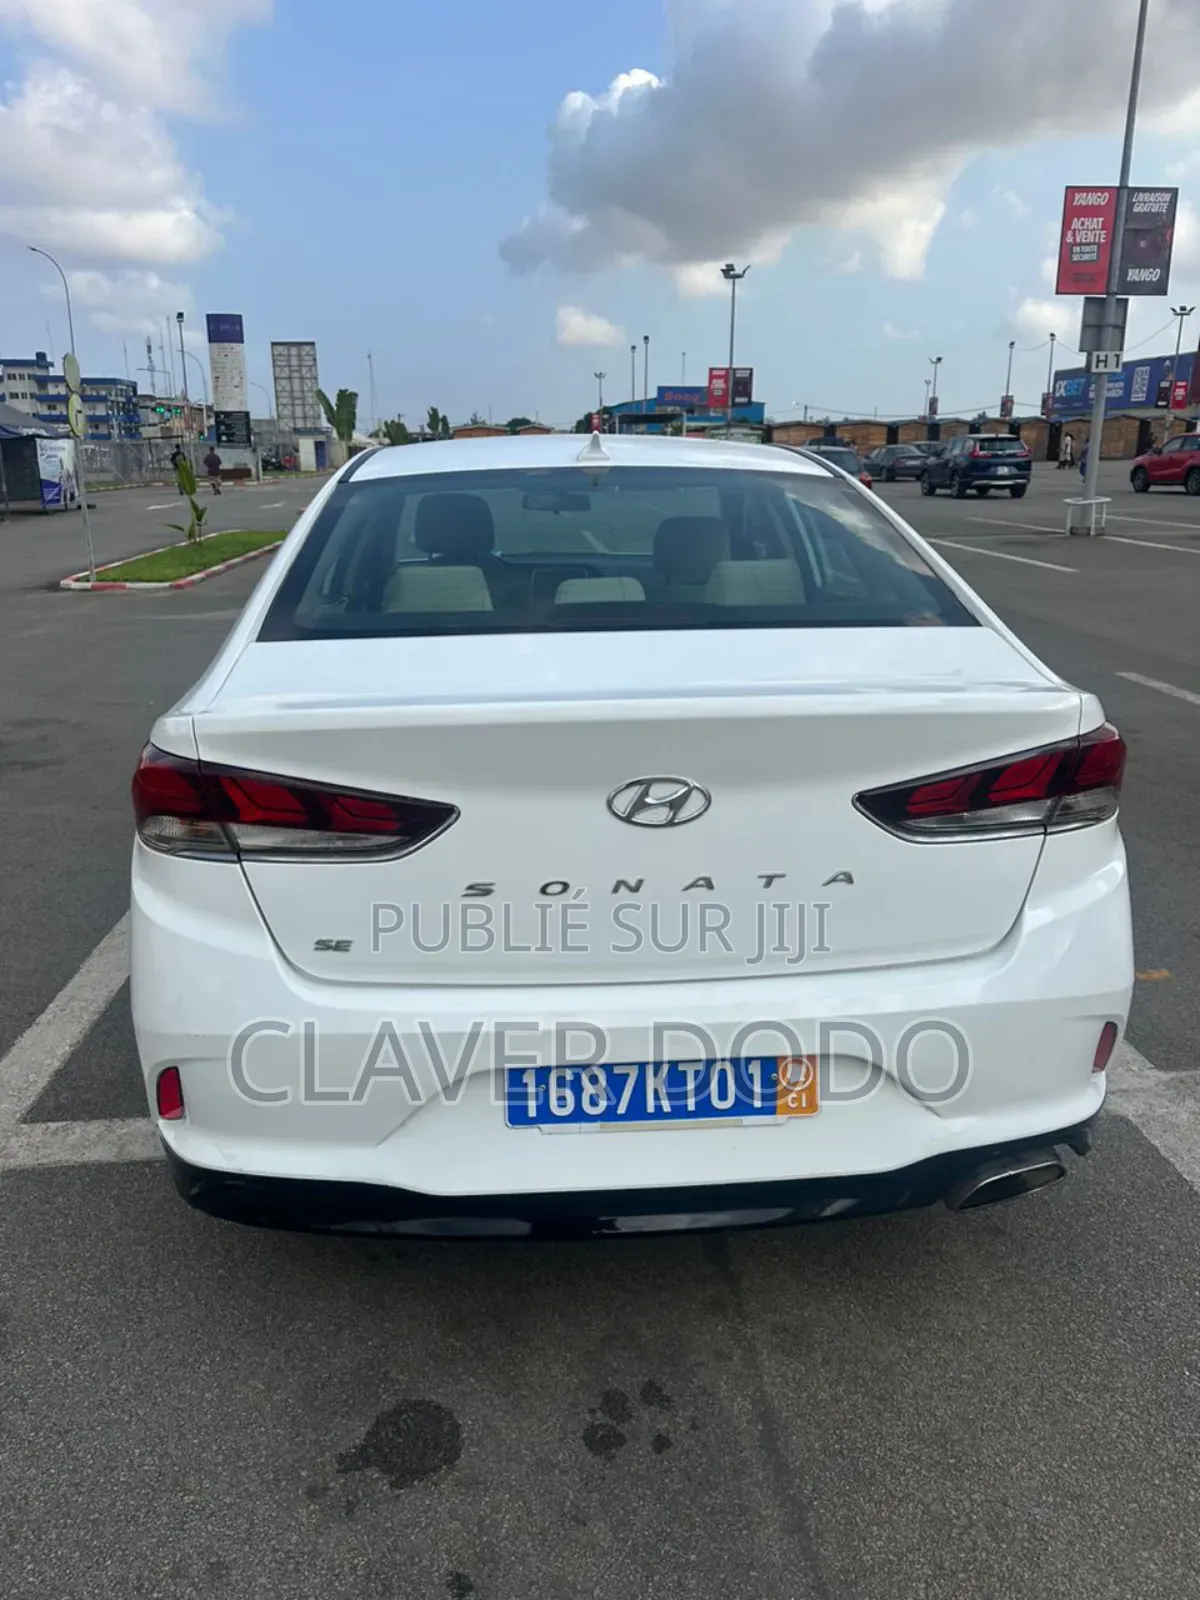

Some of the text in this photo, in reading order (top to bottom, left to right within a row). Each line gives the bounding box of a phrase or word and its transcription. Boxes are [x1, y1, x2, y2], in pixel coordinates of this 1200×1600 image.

[1073, 192, 1109, 206] YANGO
[1132, 192, 1172, 202] LIVRAISON
[1133, 203, 1169, 213] GRATUITE
[1071, 217, 1104, 230] ACHAT
[1066, 230, 1107, 243] & VENTE
[1126, 268, 1161, 282] YANGO
[461, 870, 856, 898] SONATA
[313, 938, 353, 953] SE
[521, 1059, 808, 1118] 1687KT01 CI
